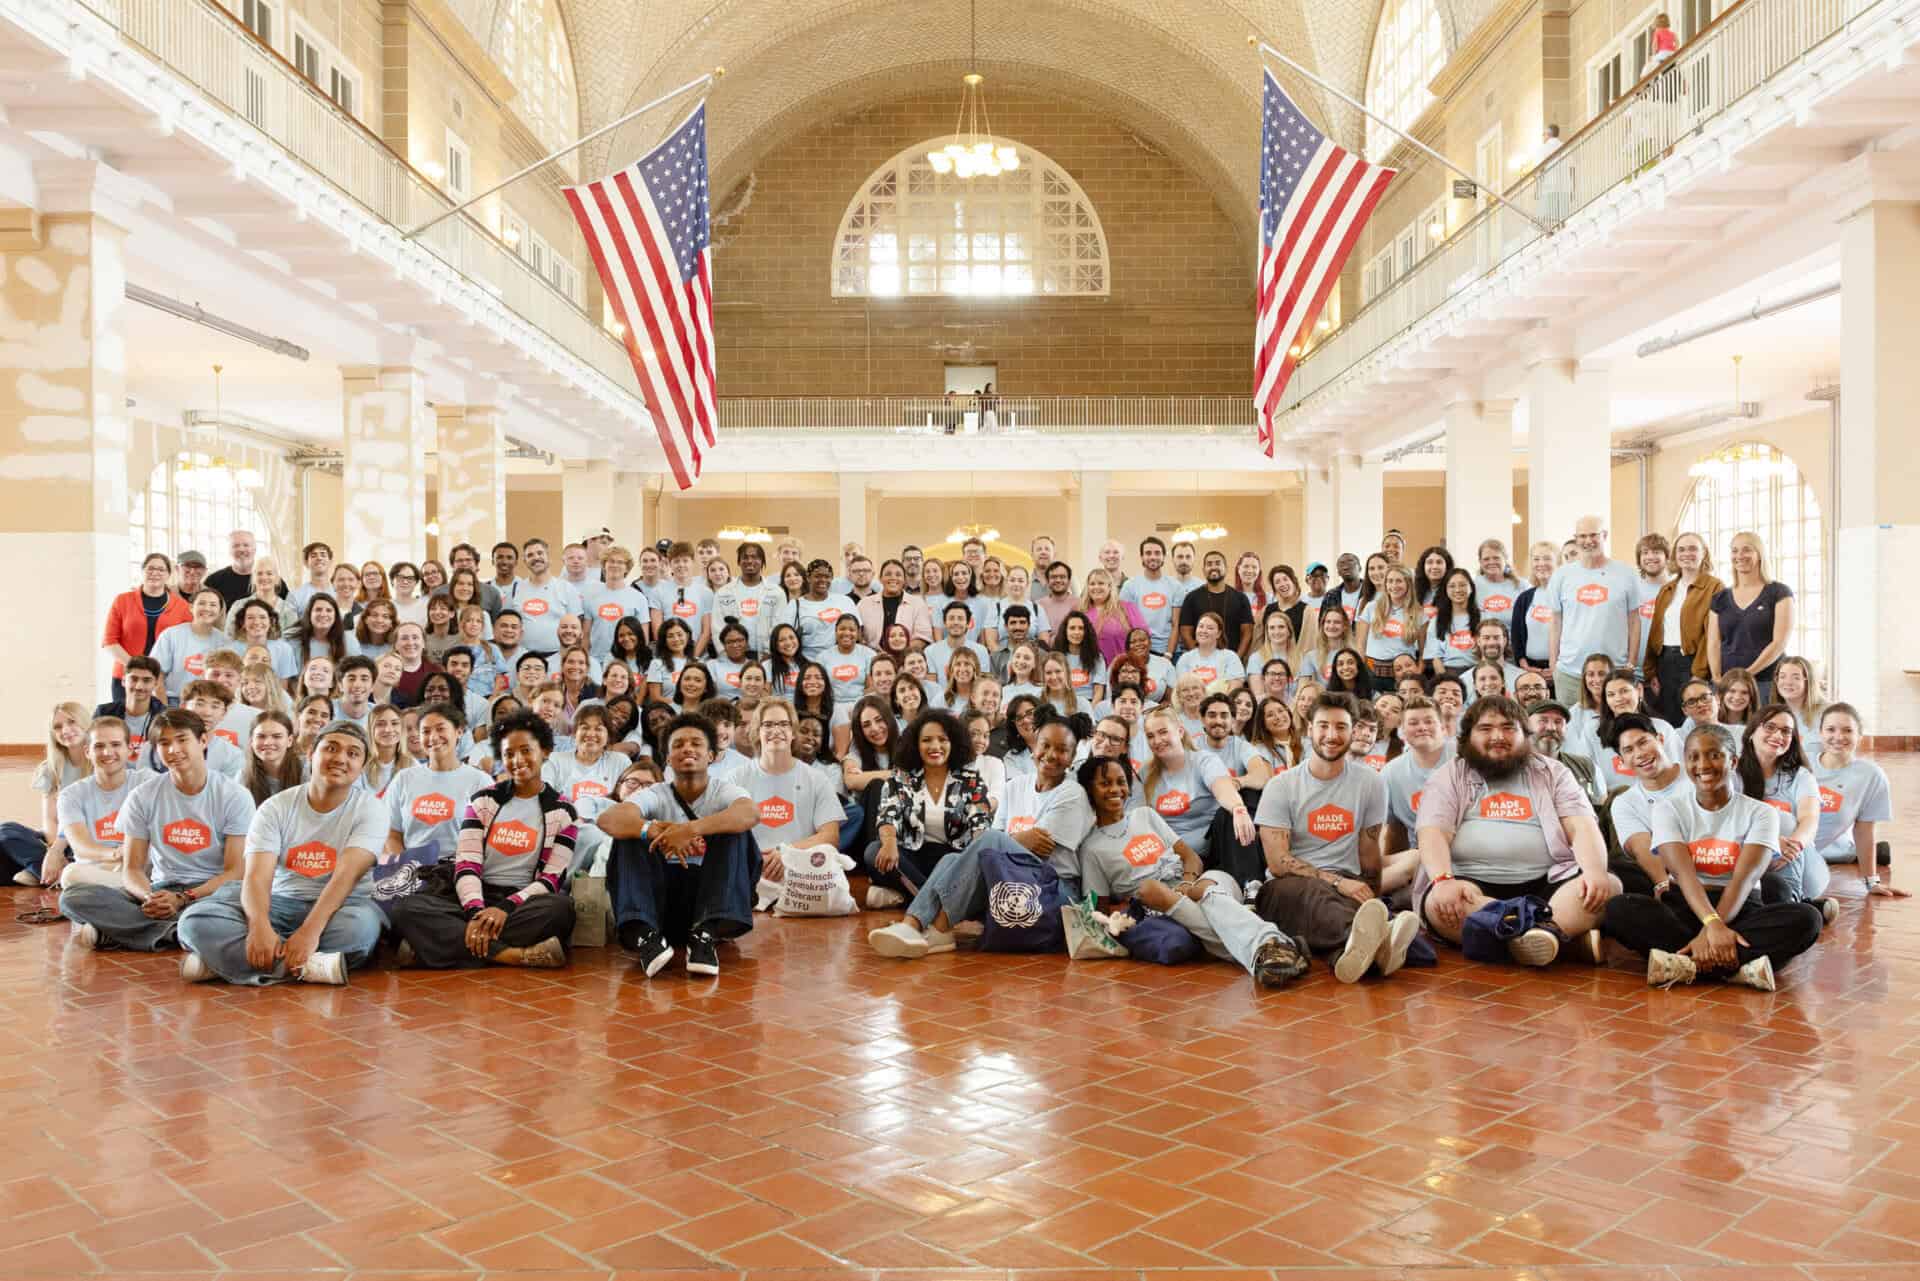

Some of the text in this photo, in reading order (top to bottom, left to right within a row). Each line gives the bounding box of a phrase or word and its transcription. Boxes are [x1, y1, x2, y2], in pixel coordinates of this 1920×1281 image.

[420, 799, 447, 809] MADE
[763, 804, 786, 812] MADE
[1489, 799, 1520, 809] MADE
[415, 807, 449, 816] IMPACT
[759, 810, 788, 820] IMPACT
[1486, 807, 1526, 817] IMPACT
[1316, 814, 1344, 823] MADE
[171, 827, 201, 837] MADE
[1313, 822, 1348, 832] IMPACT
[496, 827, 529, 839] MADE
[168, 835, 205, 845] IMPACT
[492, 834, 530, 848] IMPACT
[297, 851, 326, 861] MADE
[1696, 847, 1729, 857] MADE
[292, 858, 330, 869] IMPACT
[1692, 855, 1736, 865] IMPACT
[792, 900, 809, 911] YFU
